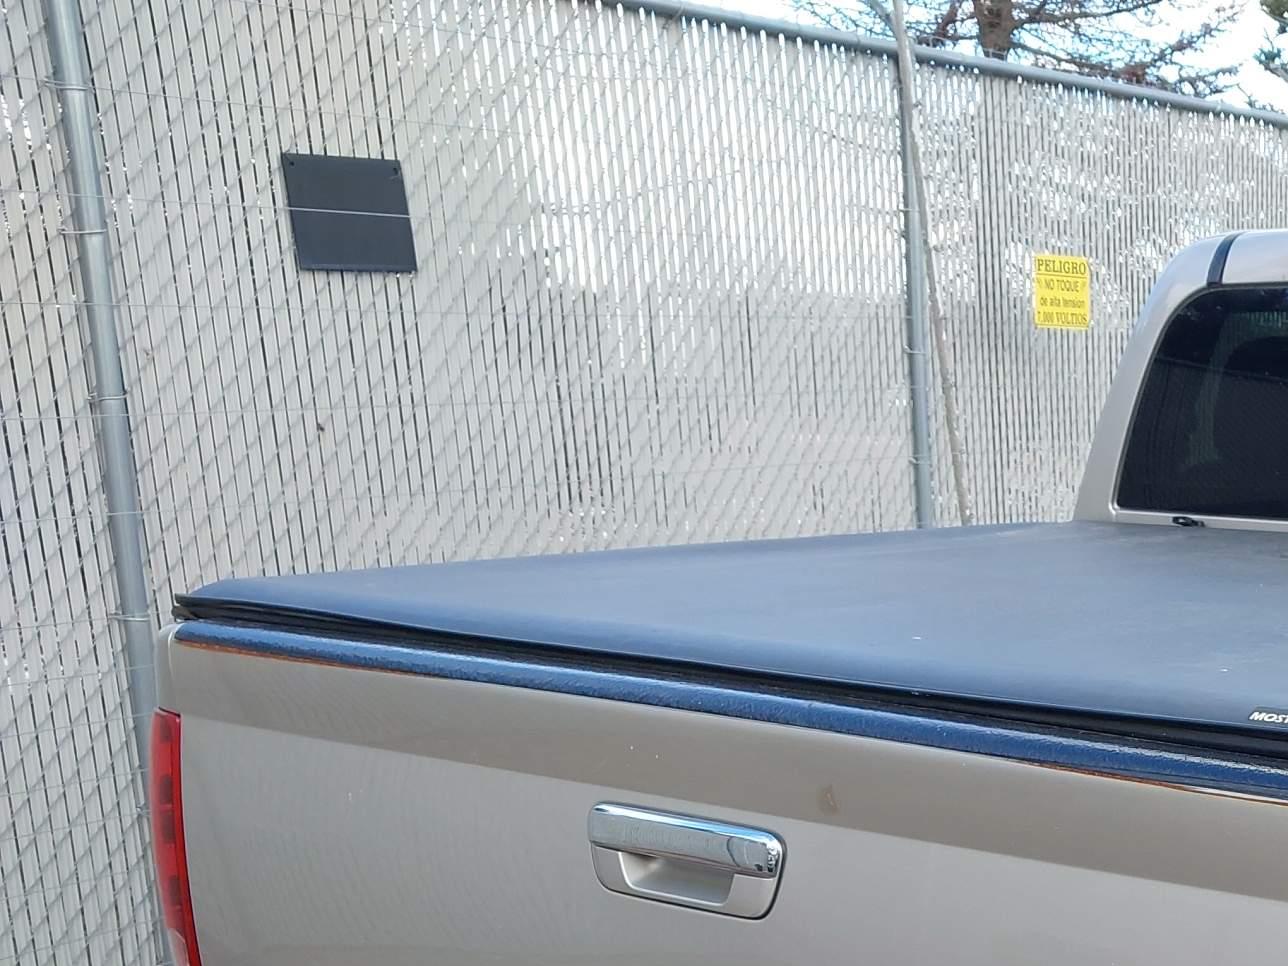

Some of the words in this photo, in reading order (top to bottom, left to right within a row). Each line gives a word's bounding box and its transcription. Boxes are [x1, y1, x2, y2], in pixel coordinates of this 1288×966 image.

[1037, 258, 1086, 275] PELIGRO
[1044, 278, 1055, 290] NO
[1056, 279, 1080, 293] TOQUE
